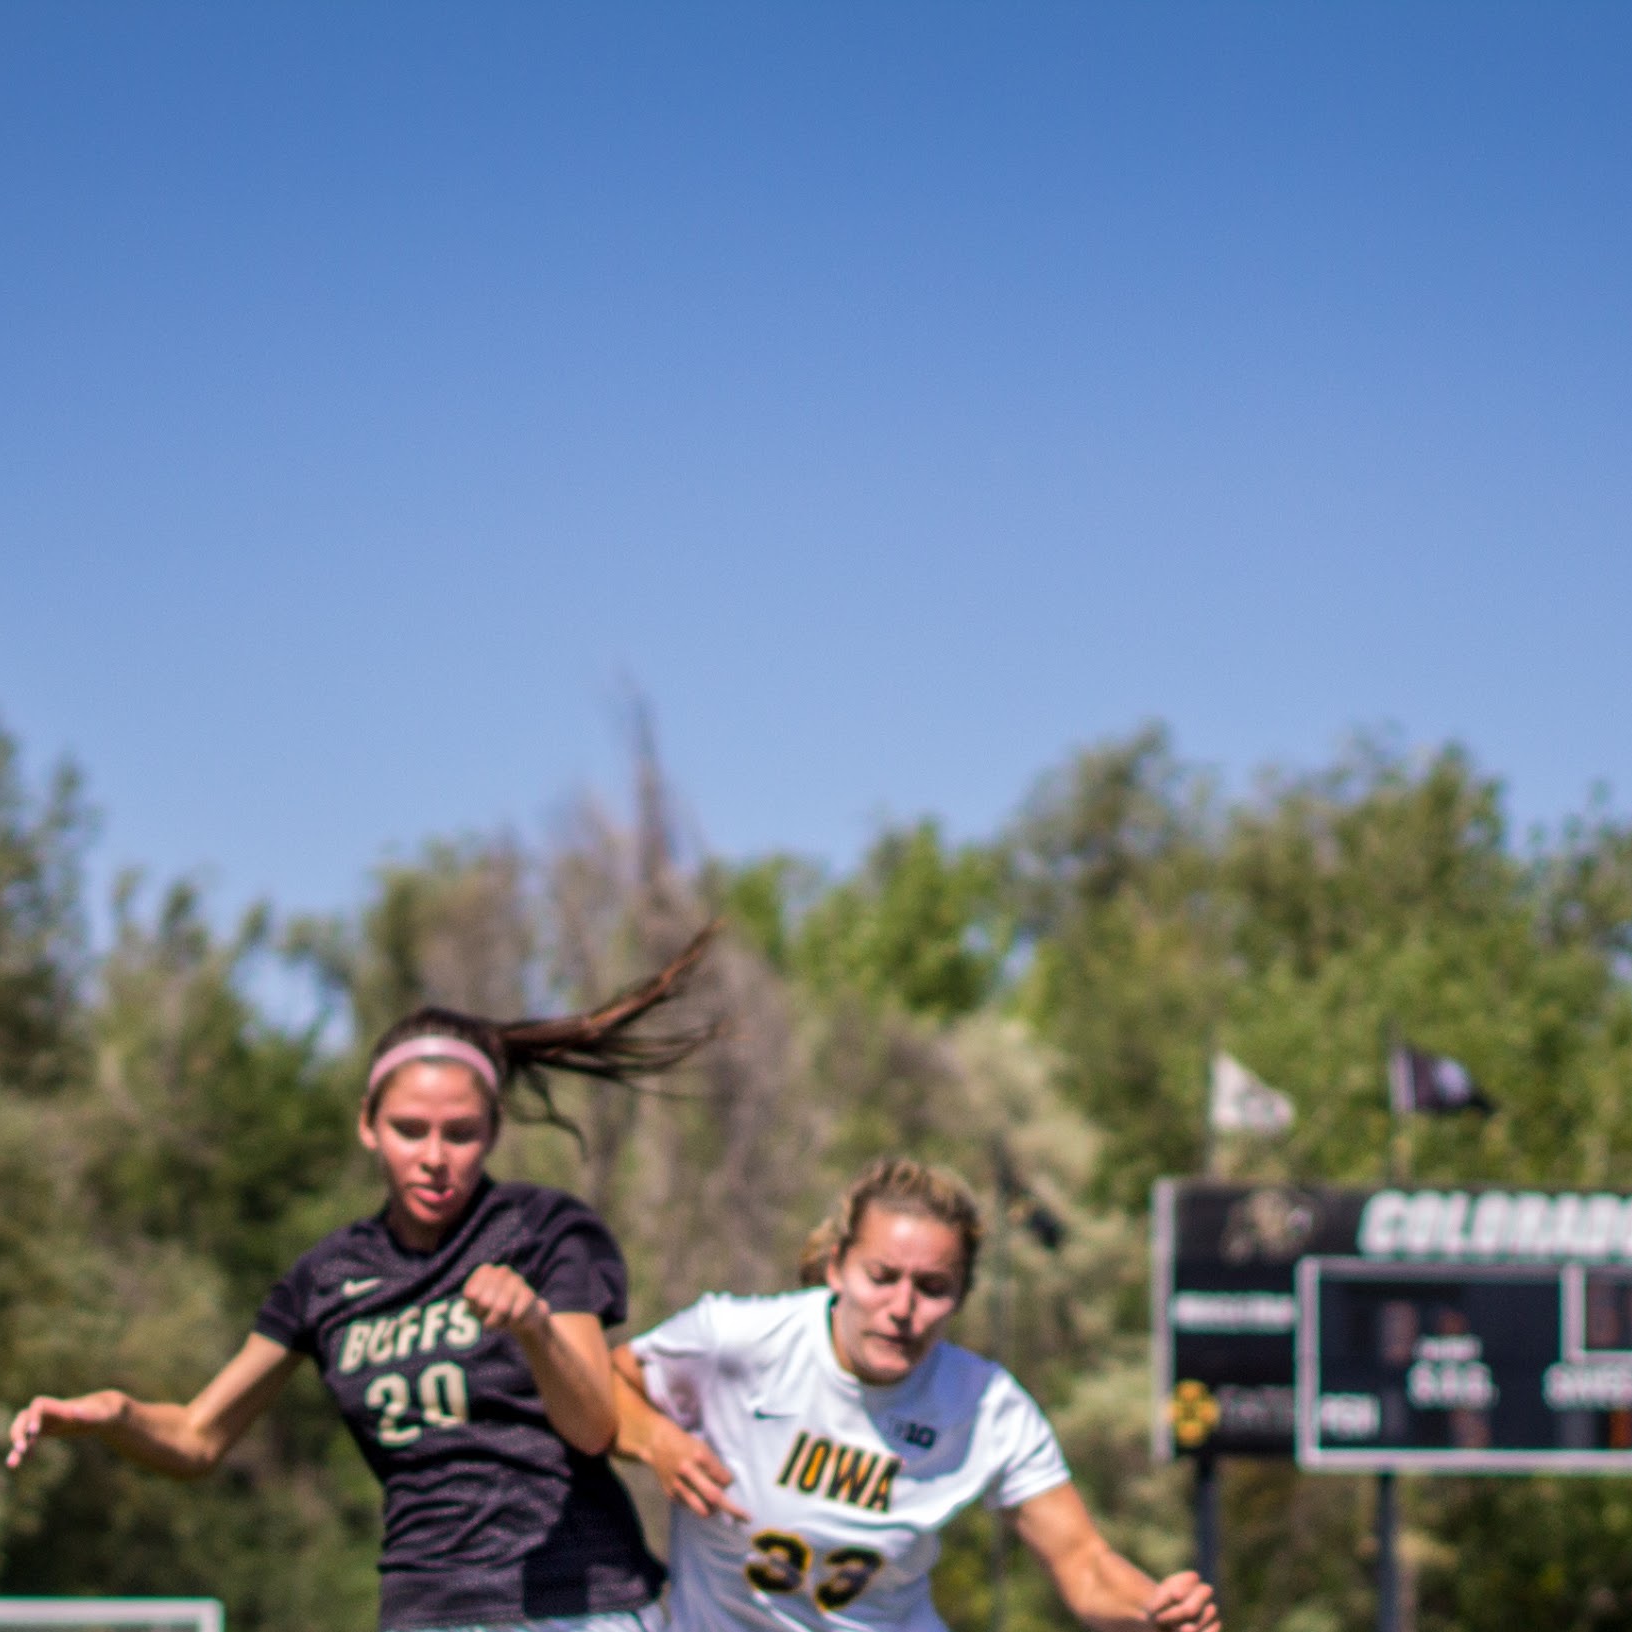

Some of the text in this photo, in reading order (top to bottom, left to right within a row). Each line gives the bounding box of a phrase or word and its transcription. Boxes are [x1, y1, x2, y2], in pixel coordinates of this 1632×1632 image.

[339, 1299, 481, 1374] BUFFS
[366, 1361, 469, 1446] 20
[776, 1431, 903, 1514] IOWA
[745, 1530, 885, 1612] 33
